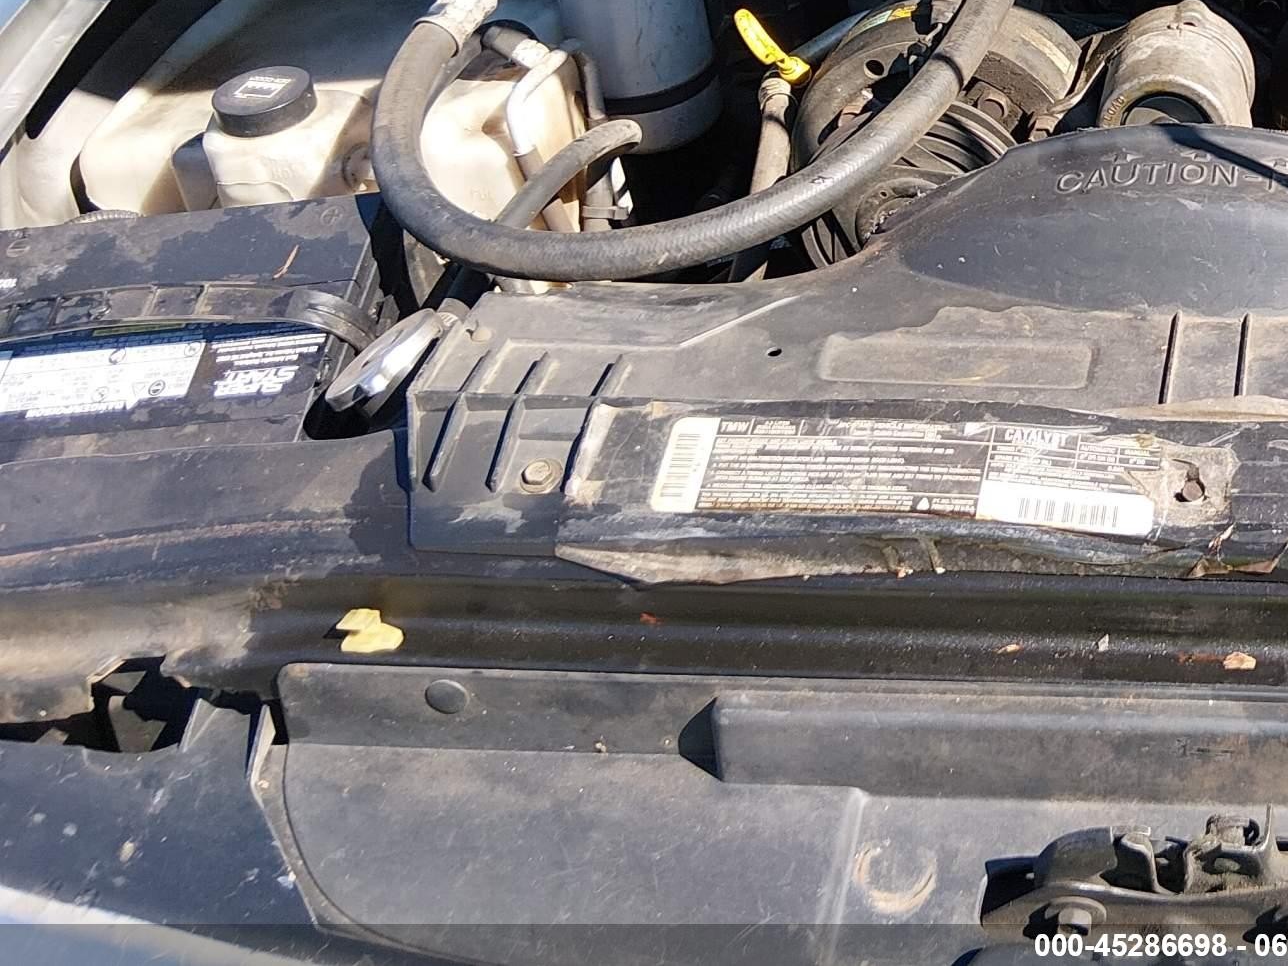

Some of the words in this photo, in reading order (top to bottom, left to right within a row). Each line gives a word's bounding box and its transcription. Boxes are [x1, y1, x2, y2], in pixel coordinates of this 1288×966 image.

[224, 365, 300, 383] START
[213, 381, 283, 398] SUPER
[720, 421, 750, 434] TMW
[1004, 428, 1069, 447] CATALYST
